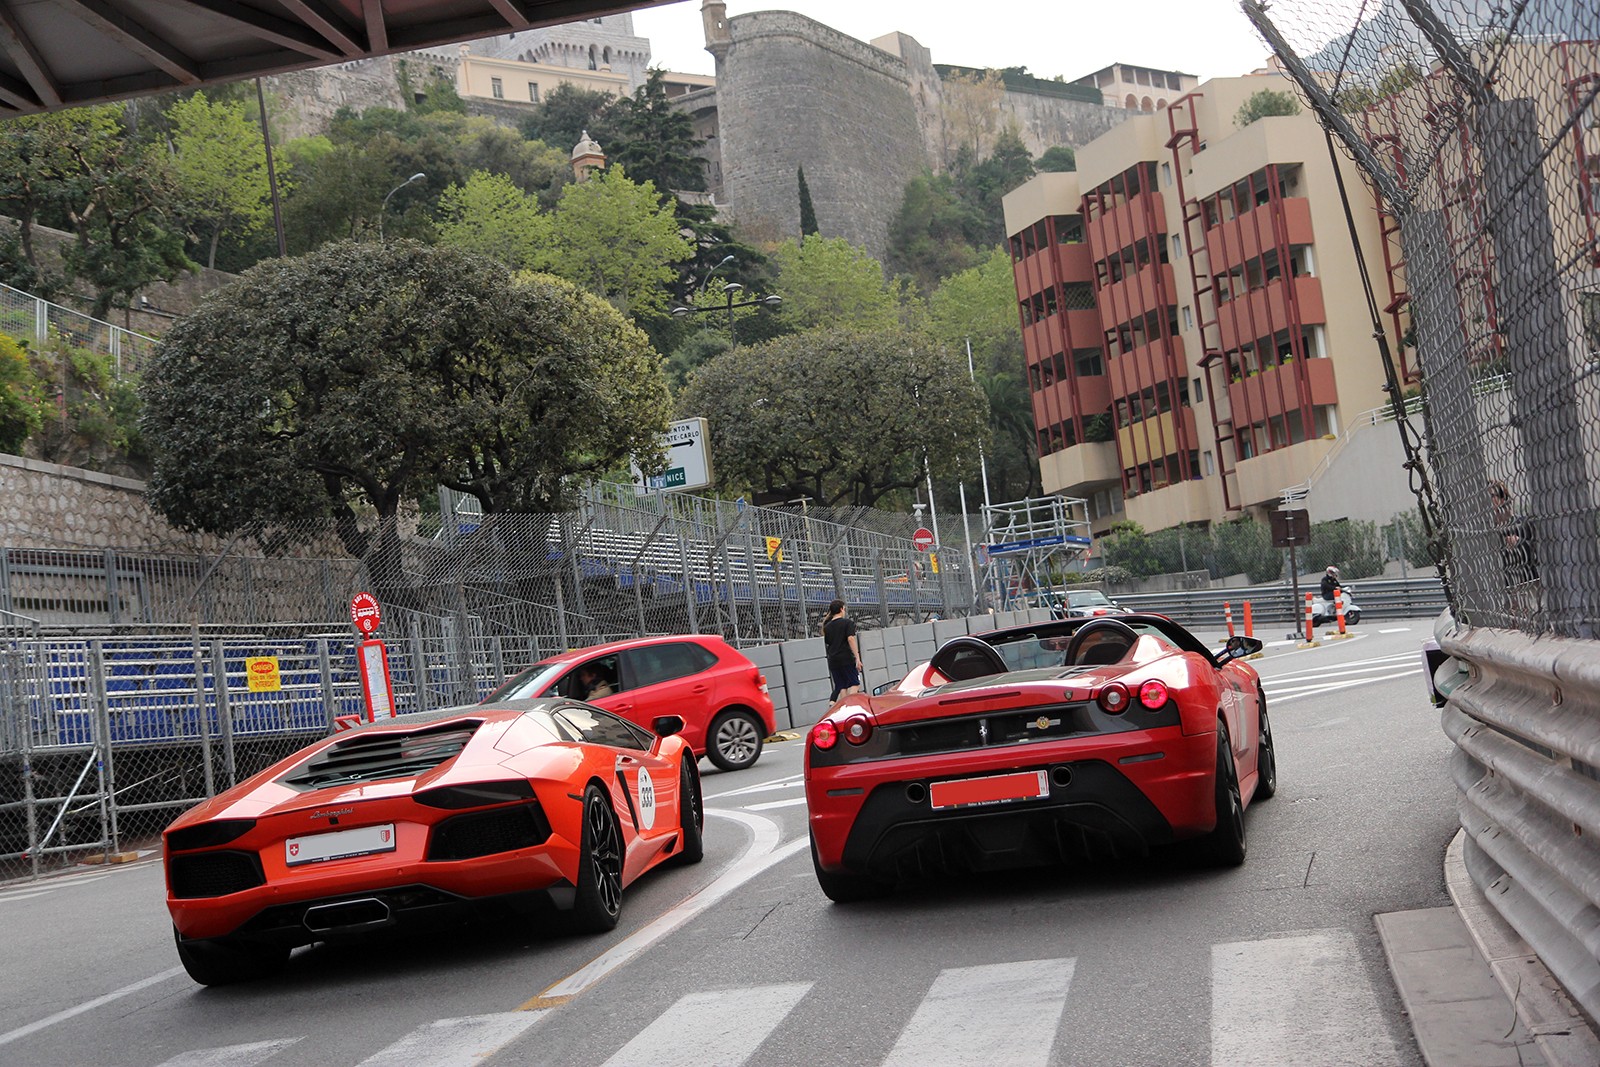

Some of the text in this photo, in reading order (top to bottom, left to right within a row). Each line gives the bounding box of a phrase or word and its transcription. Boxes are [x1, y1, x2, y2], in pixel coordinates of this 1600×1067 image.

[666, 472, 684, 483] NICE
[252, 663, 274, 672] DANGER
[642, 787, 652, 807] 333
[310, 807, 354, 819] Lamborghini
